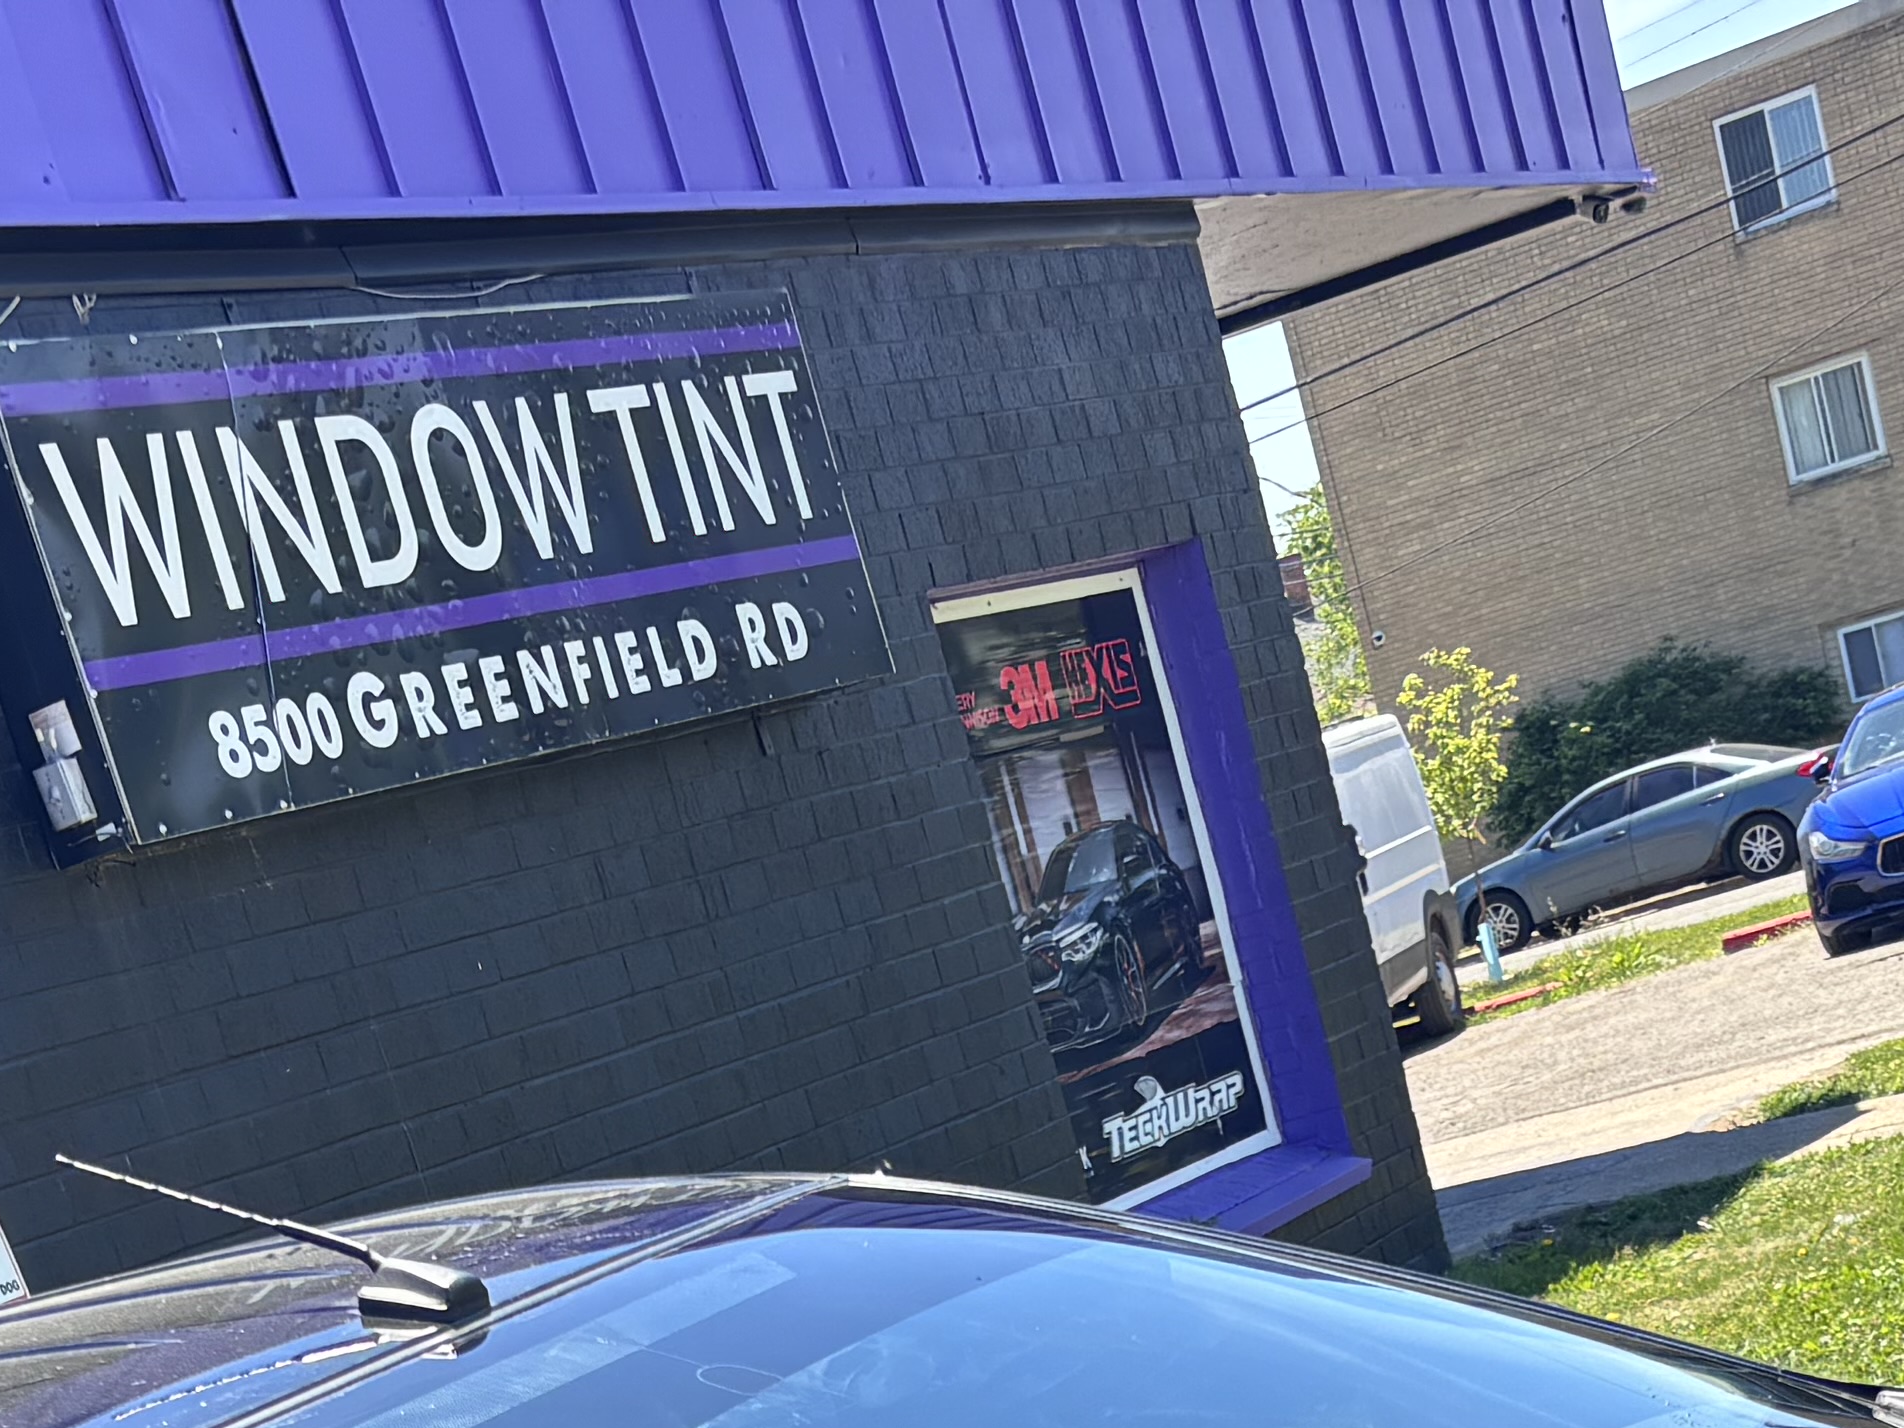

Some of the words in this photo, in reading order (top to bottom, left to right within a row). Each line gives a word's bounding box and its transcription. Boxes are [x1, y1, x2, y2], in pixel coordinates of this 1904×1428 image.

[39, 392, 593, 627] WINDOW
[587, 369, 814, 545] TINT
[208, 698, 345, 779] 8500
[346, 618, 718, 750] GREENFIELD
[737, 600, 809, 668] RD
[999, 660, 1060, 730] 3M
[0, 1279, 20, 1296] DOG
